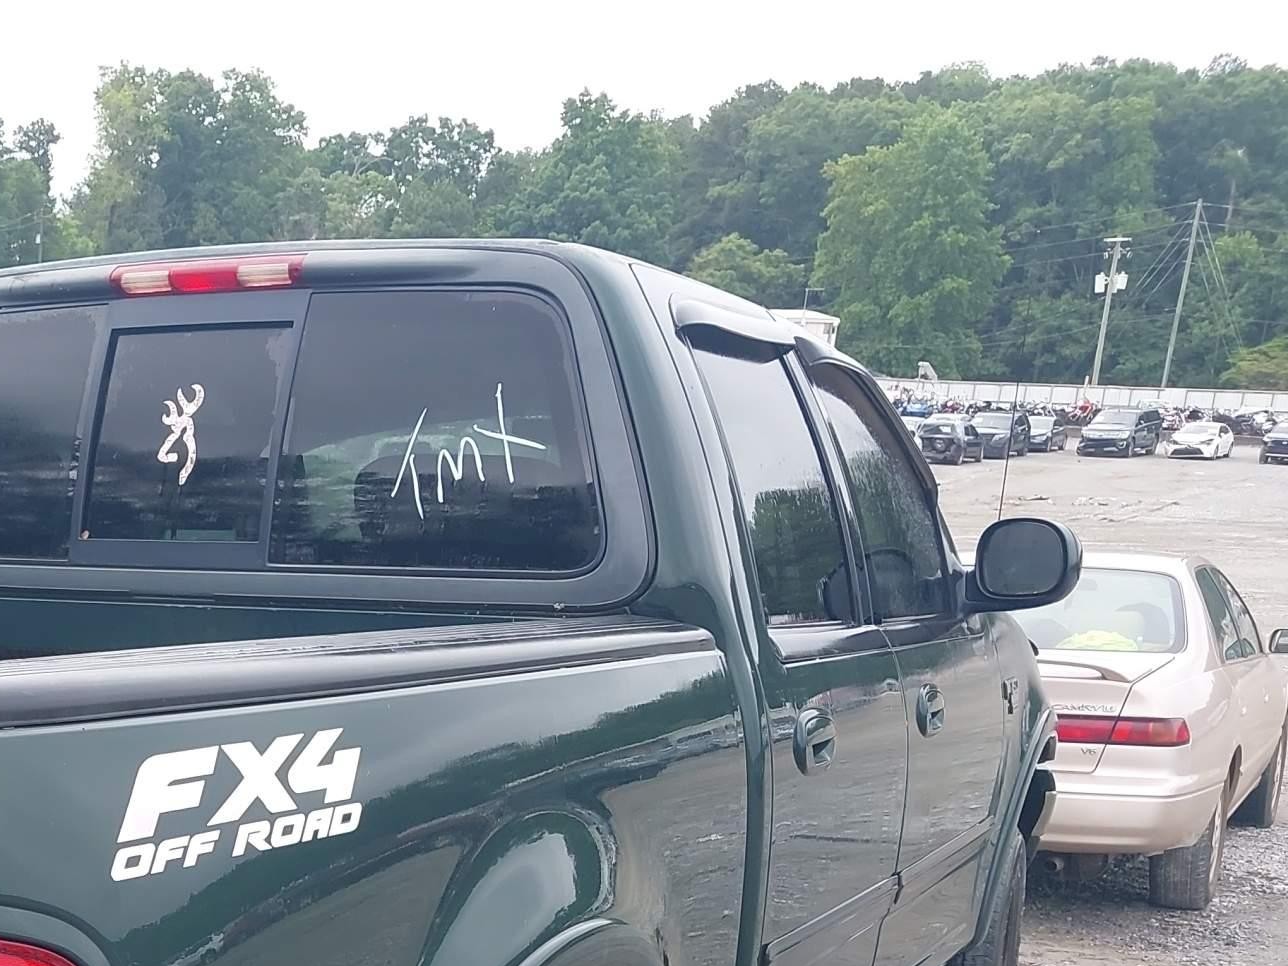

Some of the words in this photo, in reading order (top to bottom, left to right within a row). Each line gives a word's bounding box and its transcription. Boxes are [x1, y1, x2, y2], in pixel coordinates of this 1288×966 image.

[117, 727, 361, 842] FX4
[111, 829, 221, 881] OFF
[232, 802, 362, 858] ROAD
